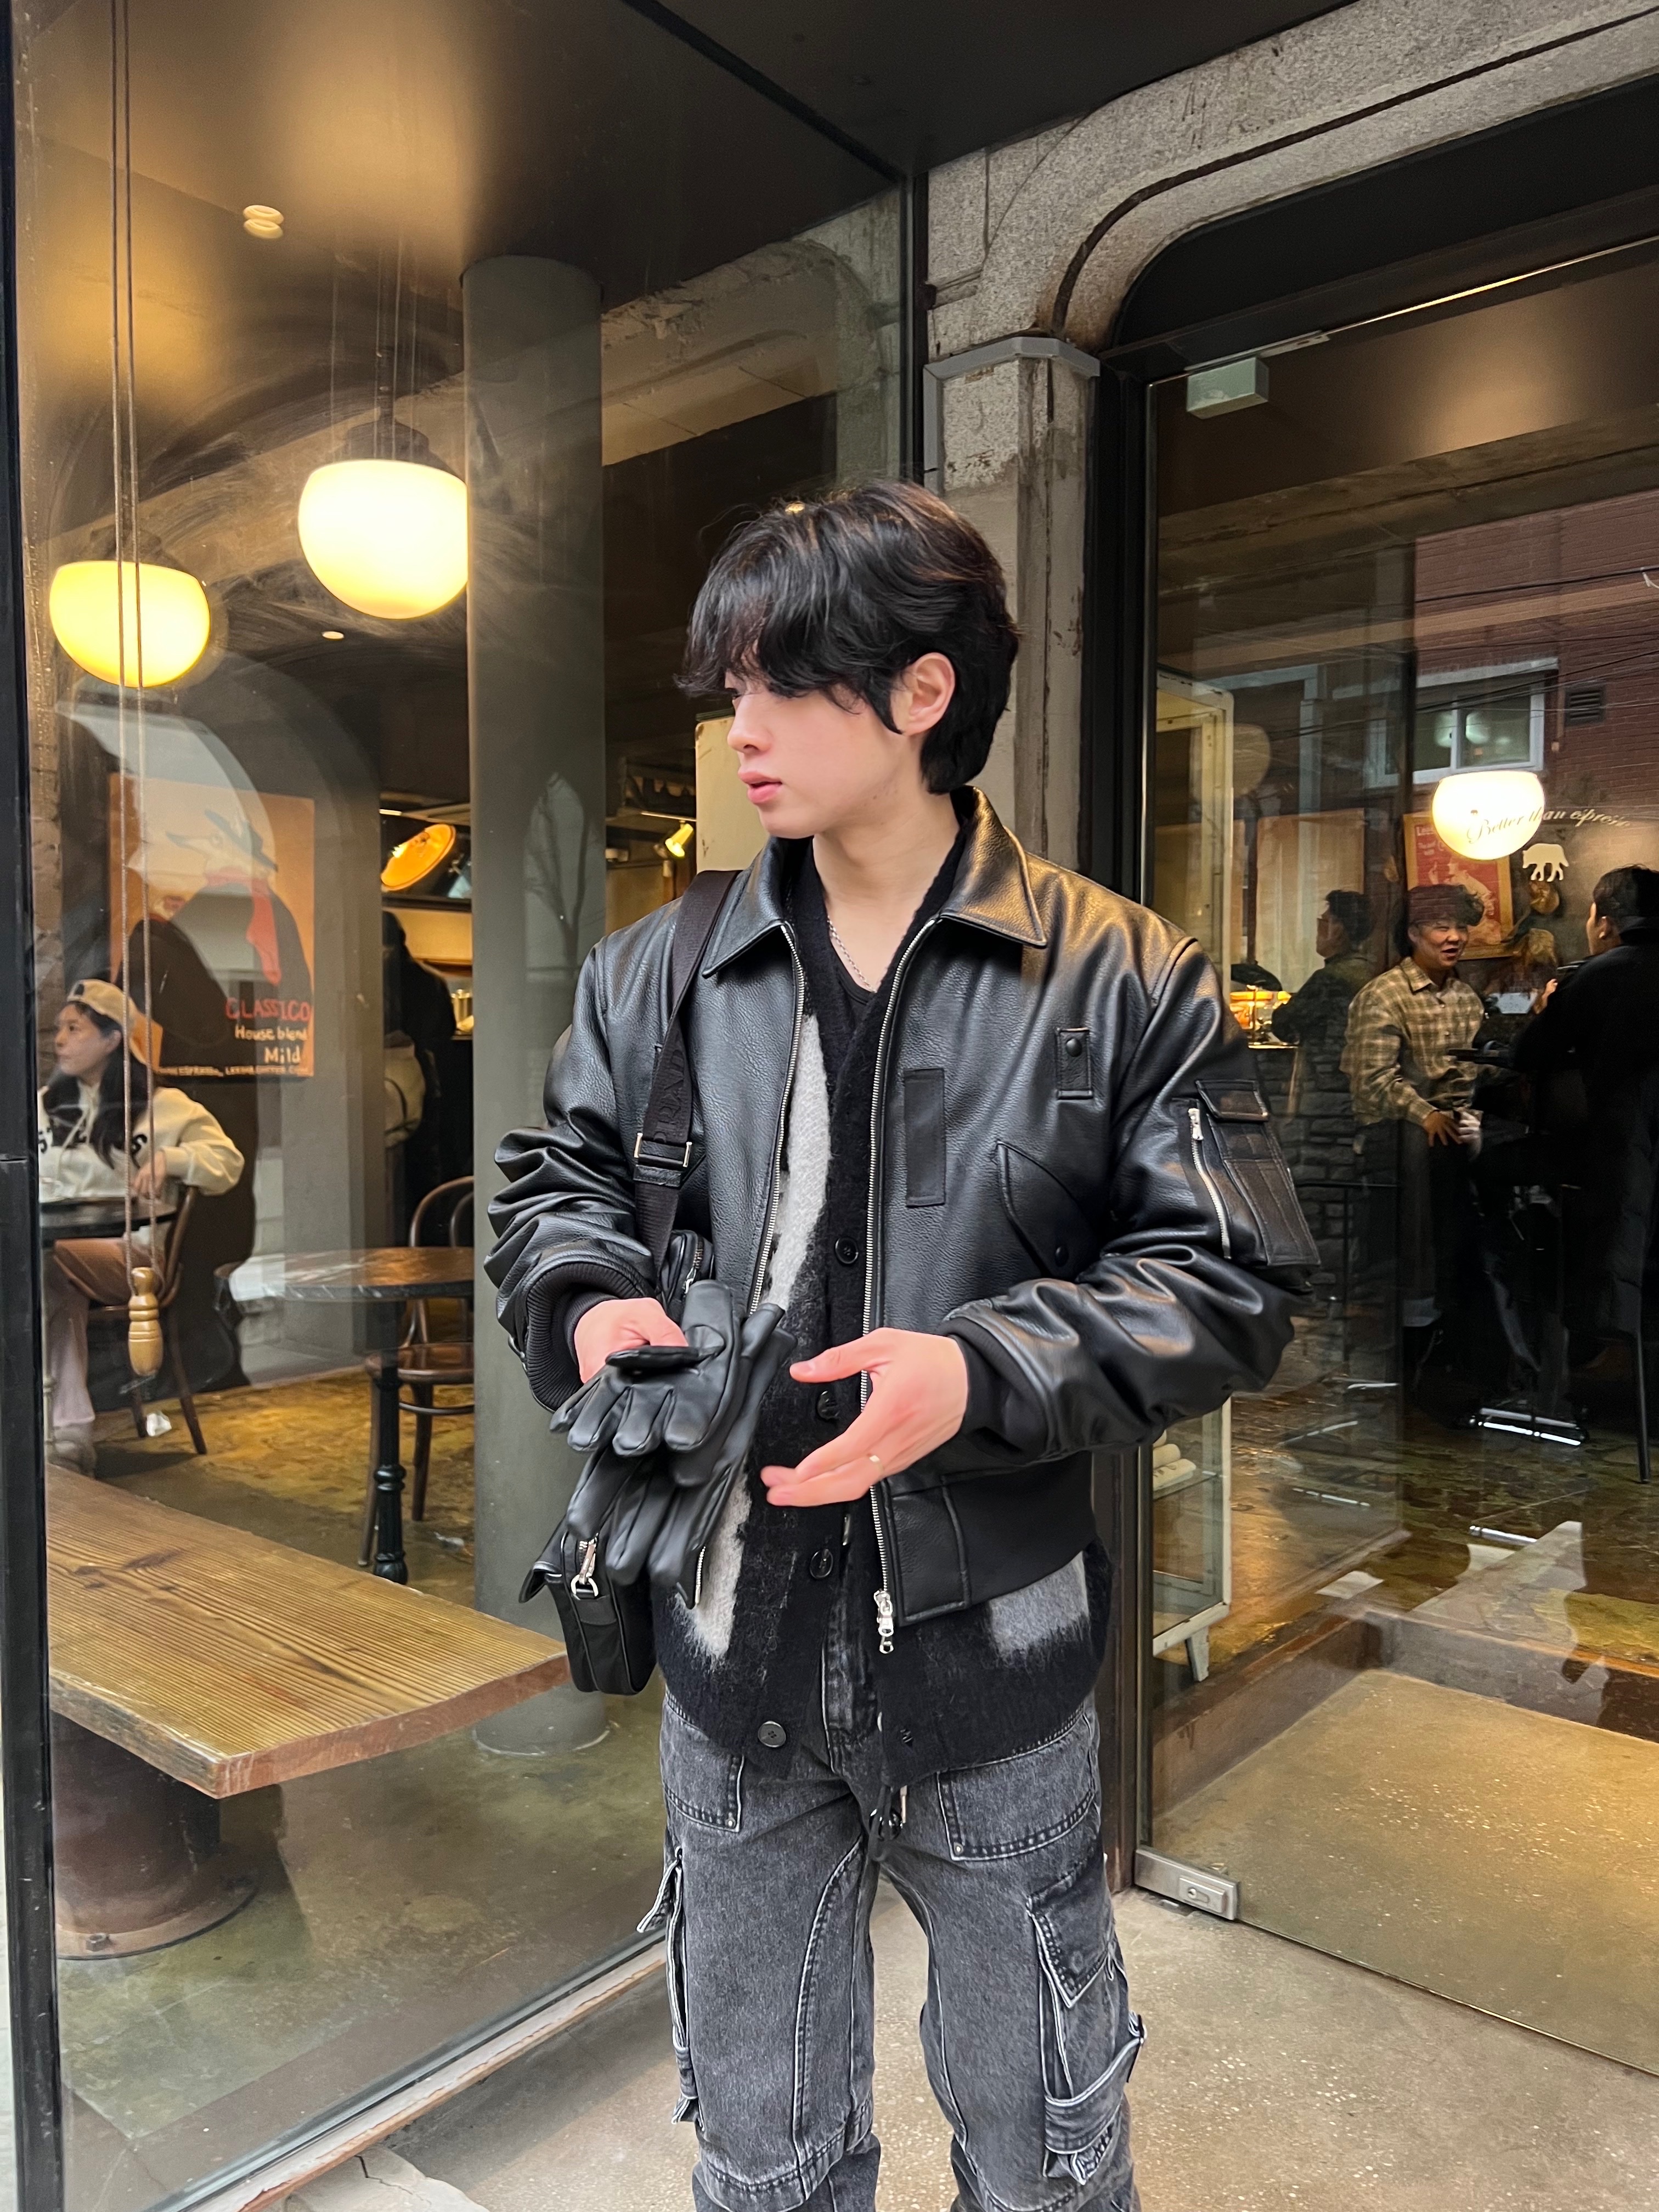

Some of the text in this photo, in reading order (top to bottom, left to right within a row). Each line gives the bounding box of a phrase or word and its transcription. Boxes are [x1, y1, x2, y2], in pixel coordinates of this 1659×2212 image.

[1466, 816, 1524, 844] Better
[1528, 806, 1565, 822] than
[225, 997, 311, 1021] CLASSICO
[235, 1024, 275, 1041] House
[264, 1045, 301, 1063] Mild
